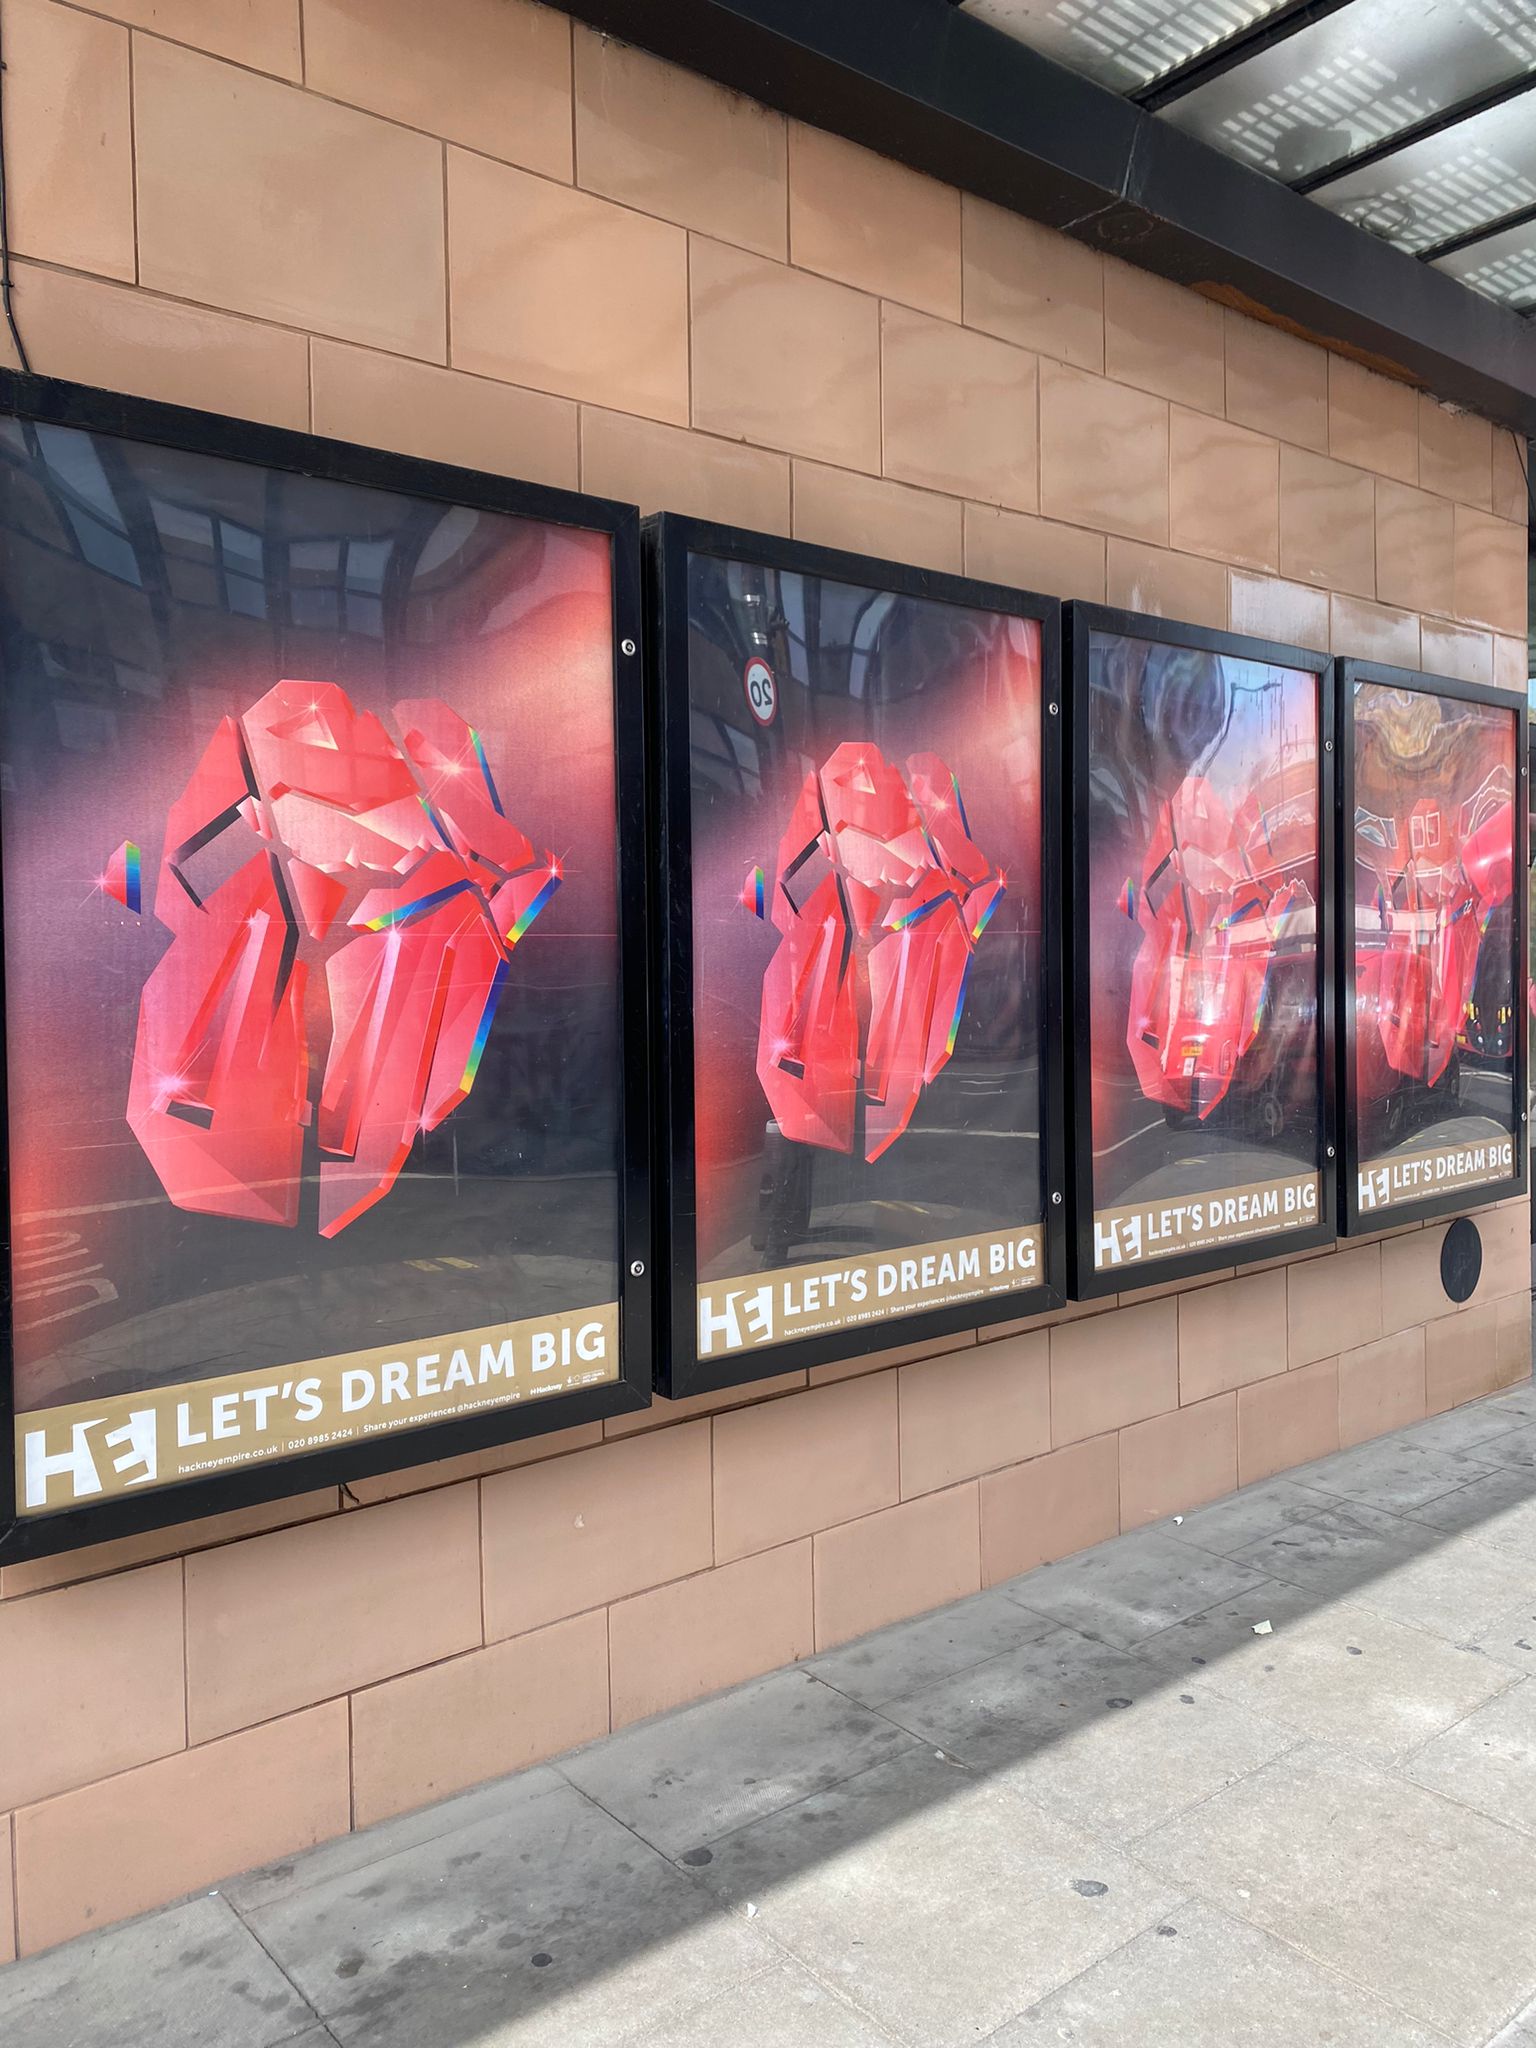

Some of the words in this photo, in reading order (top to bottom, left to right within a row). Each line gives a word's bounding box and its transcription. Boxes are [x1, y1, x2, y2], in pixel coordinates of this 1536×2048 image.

[1393, 1159, 1433, 1189] LET'S
[1436, 1148, 1485, 1180] DREAM
[1489, 1143, 1512, 1168] BIG
[1148, 1204, 1203, 1240] LET'S
[1209, 1190, 1278, 1228] DREAM
[1285, 1183, 1316, 1213] BIG
[784, 1268, 868, 1317] LET'S
[878, 1247, 980, 1297] DREAM
[989, 1238, 1036, 1274] BIG
[890, 1302, 905, 1314] Share
[905, 1299, 917, 1311] your
[176, 1377, 323, 1448] LET'S
[341, 1339, 515, 1413] DREAM
[531, 1321, 606, 1373] BIG
[178, 1445, 278, 1474] hackneyempire.co.uk
[287, 1438, 305, 1450] 020
[307, 1433, 329, 1446] 8985
[331, 1428, 353, 1440] 2424
[363, 1421, 387, 1434] Share
[388, 1415, 408, 1430] your
[409, 1405, 456, 1424] experiences
[456, 1391, 521, 1413] @hackneyempire
